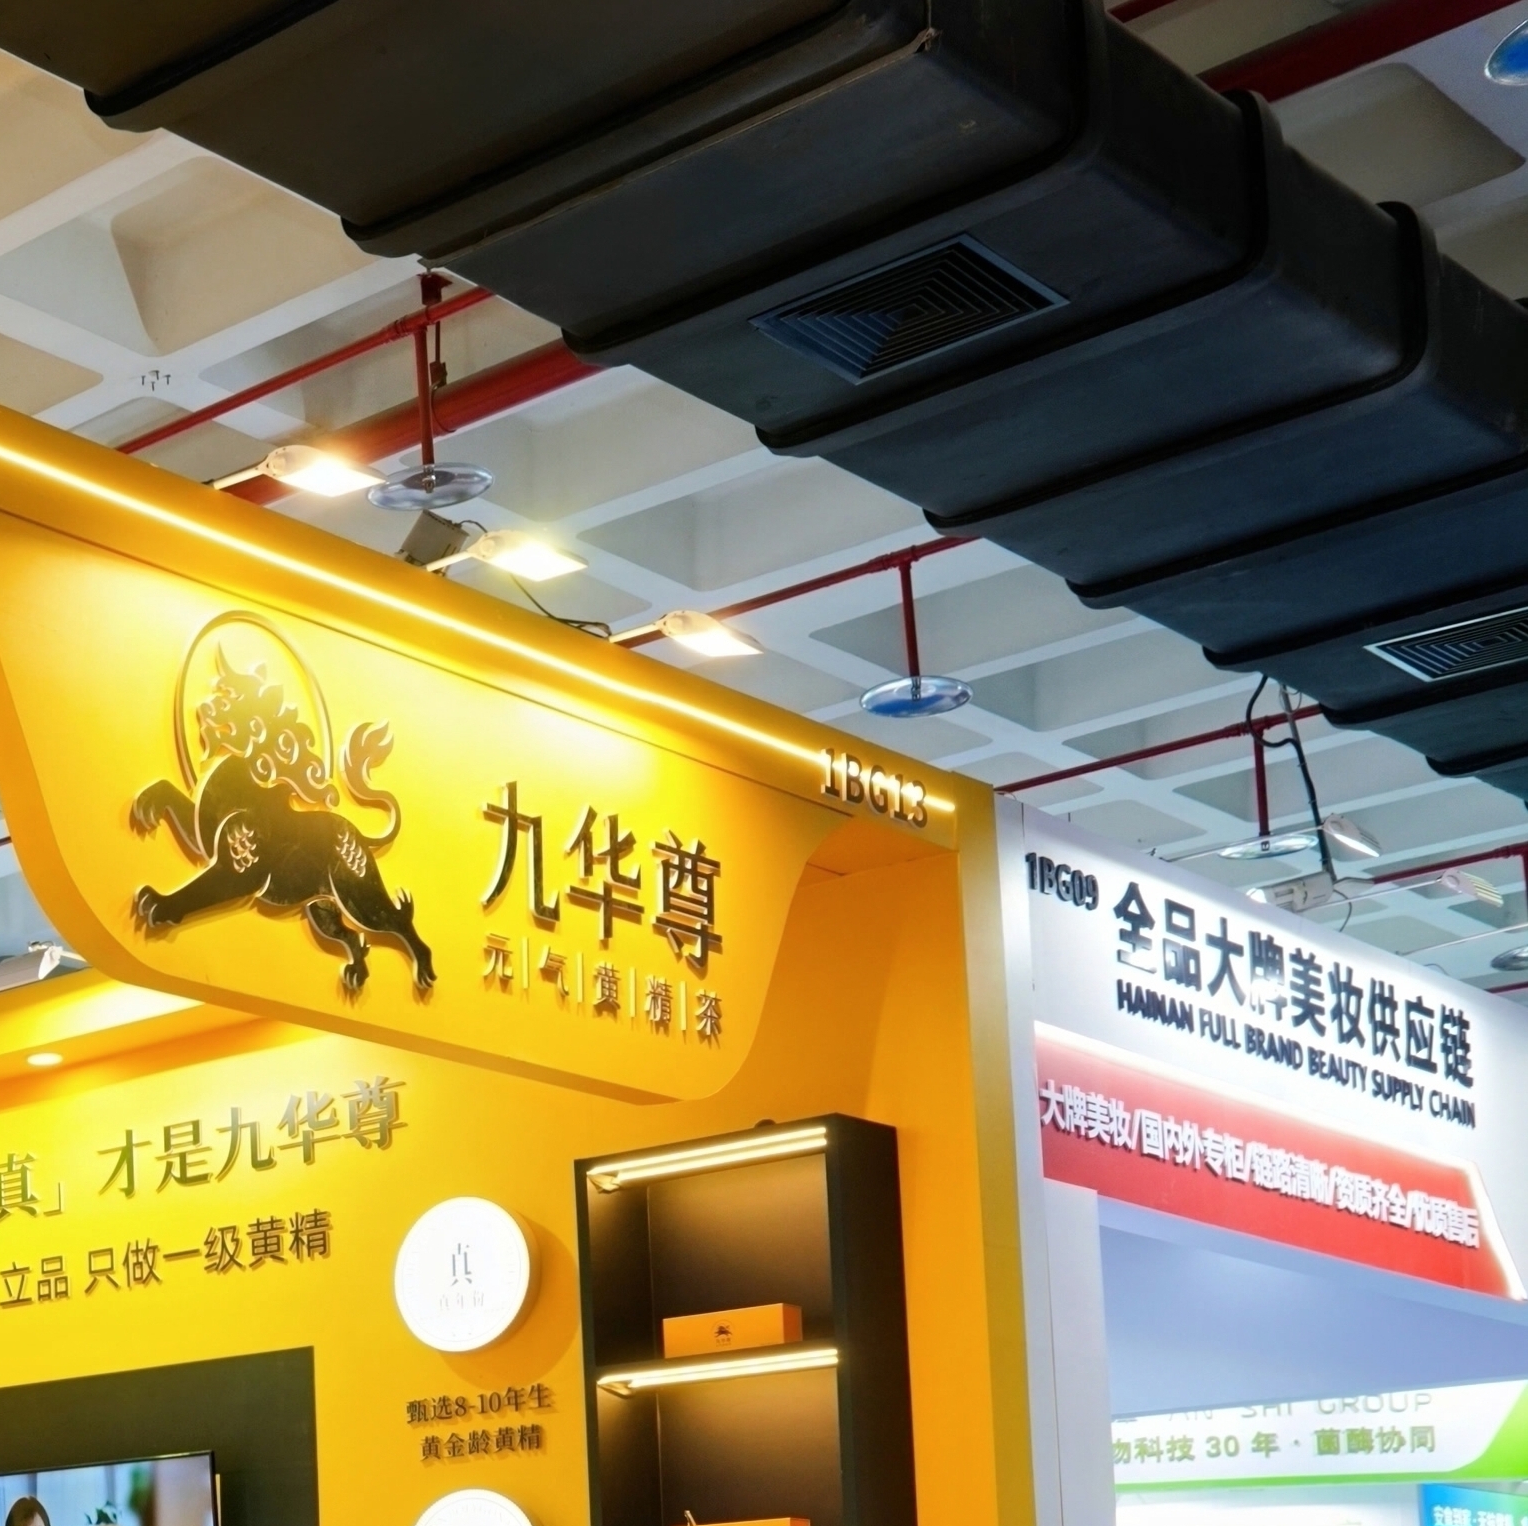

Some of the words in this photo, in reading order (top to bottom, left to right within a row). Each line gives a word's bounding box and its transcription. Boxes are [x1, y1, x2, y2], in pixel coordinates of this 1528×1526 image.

[819, 747, 929, 830] 1BG13
[480, 780, 723, 969] 九华尊
[1025, 852, 1099, 910] 1BG09
[1113, 881, 1473, 1087] 全品大牌美妆供应链
[1117, 978, 1195, 1033] HAINAN
[1199, 1007, 1241, 1050] FULL
[1245, 1024, 1304, 1071] BRAND
[1308, 1046, 1368, 1093] BEAUTY
[1372, 1068, 1425, 1112] SUPPLY
[1428, 1088, 1476, 1130] CHAIN
[98, 1075, 406, 1197] 才是九华尊
[85, 1208, 333, 1295] 只做一级黄精
[406, 1383, 552, 1424] 甄选8-10年生
[420, 1423, 542, 1462] 黄金龄黄精
[1206, 1436, 1240, 1459] 30
[1252, 1430, 1280, 1457] 年
